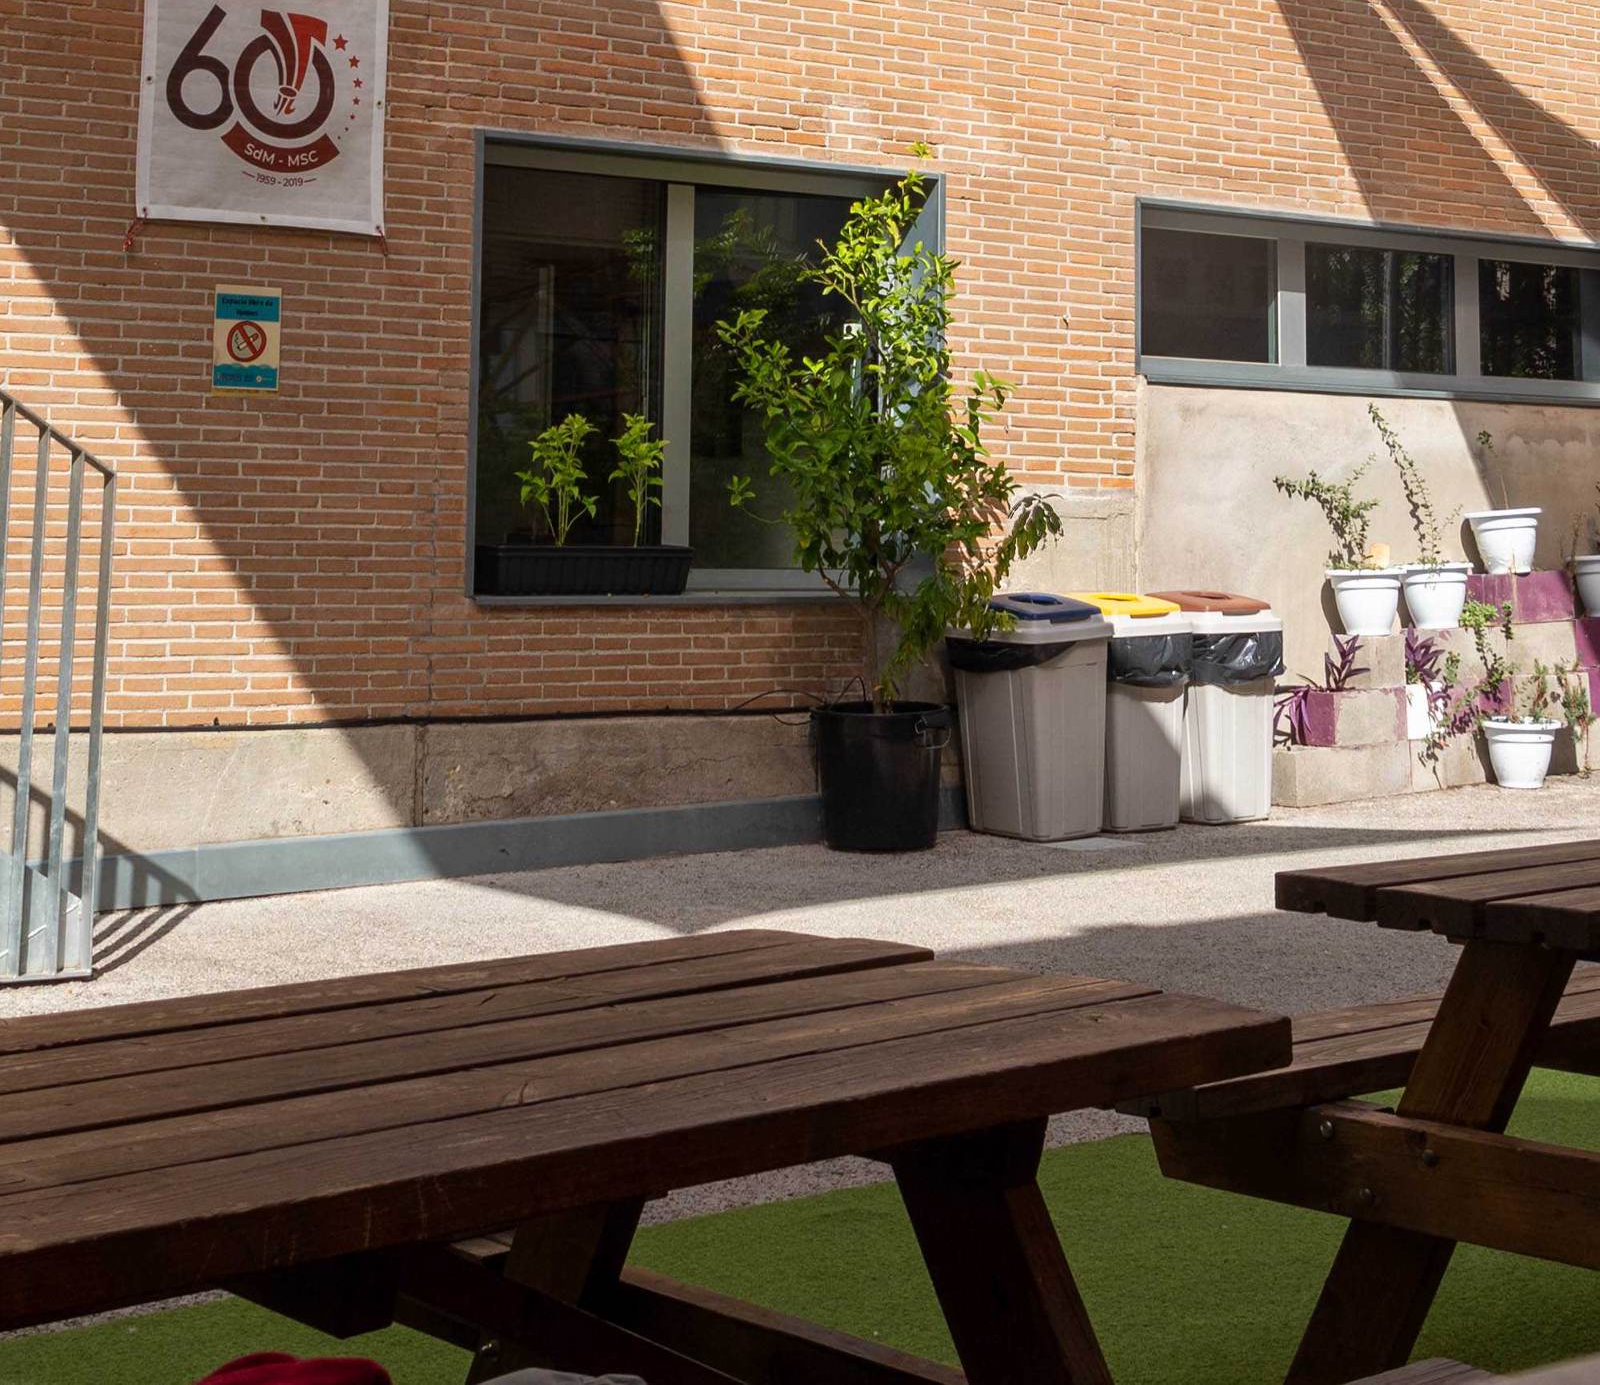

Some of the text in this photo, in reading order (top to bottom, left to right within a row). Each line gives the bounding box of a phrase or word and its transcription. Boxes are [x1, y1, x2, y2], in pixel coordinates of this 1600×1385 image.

[166, 4, 335, 140] 60
[244, 143, 275, 165] SdM
[287, 150, 319, 167] MSC
